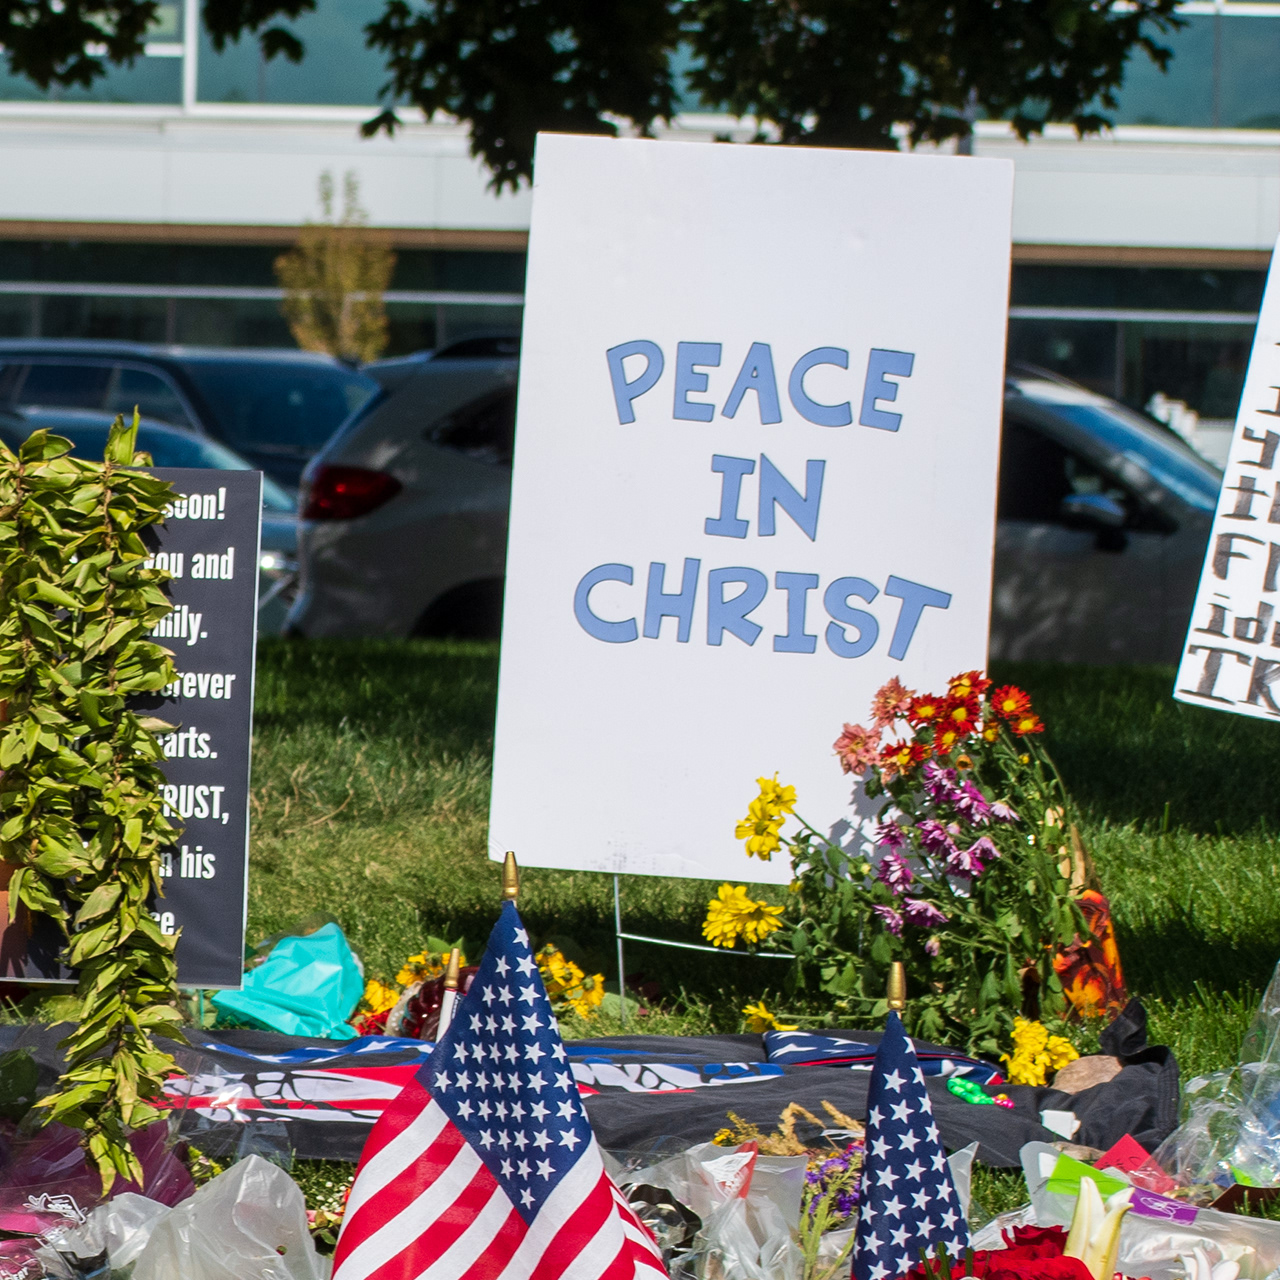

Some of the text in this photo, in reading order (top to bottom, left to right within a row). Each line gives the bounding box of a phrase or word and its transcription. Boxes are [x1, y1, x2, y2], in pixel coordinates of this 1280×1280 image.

[606, 339, 915, 432] PEACE
[704, 452, 826, 542] IN
[191, 547, 235, 579] and
[573, 557, 952, 661] CHRIST
[181, 845, 216, 879] his
